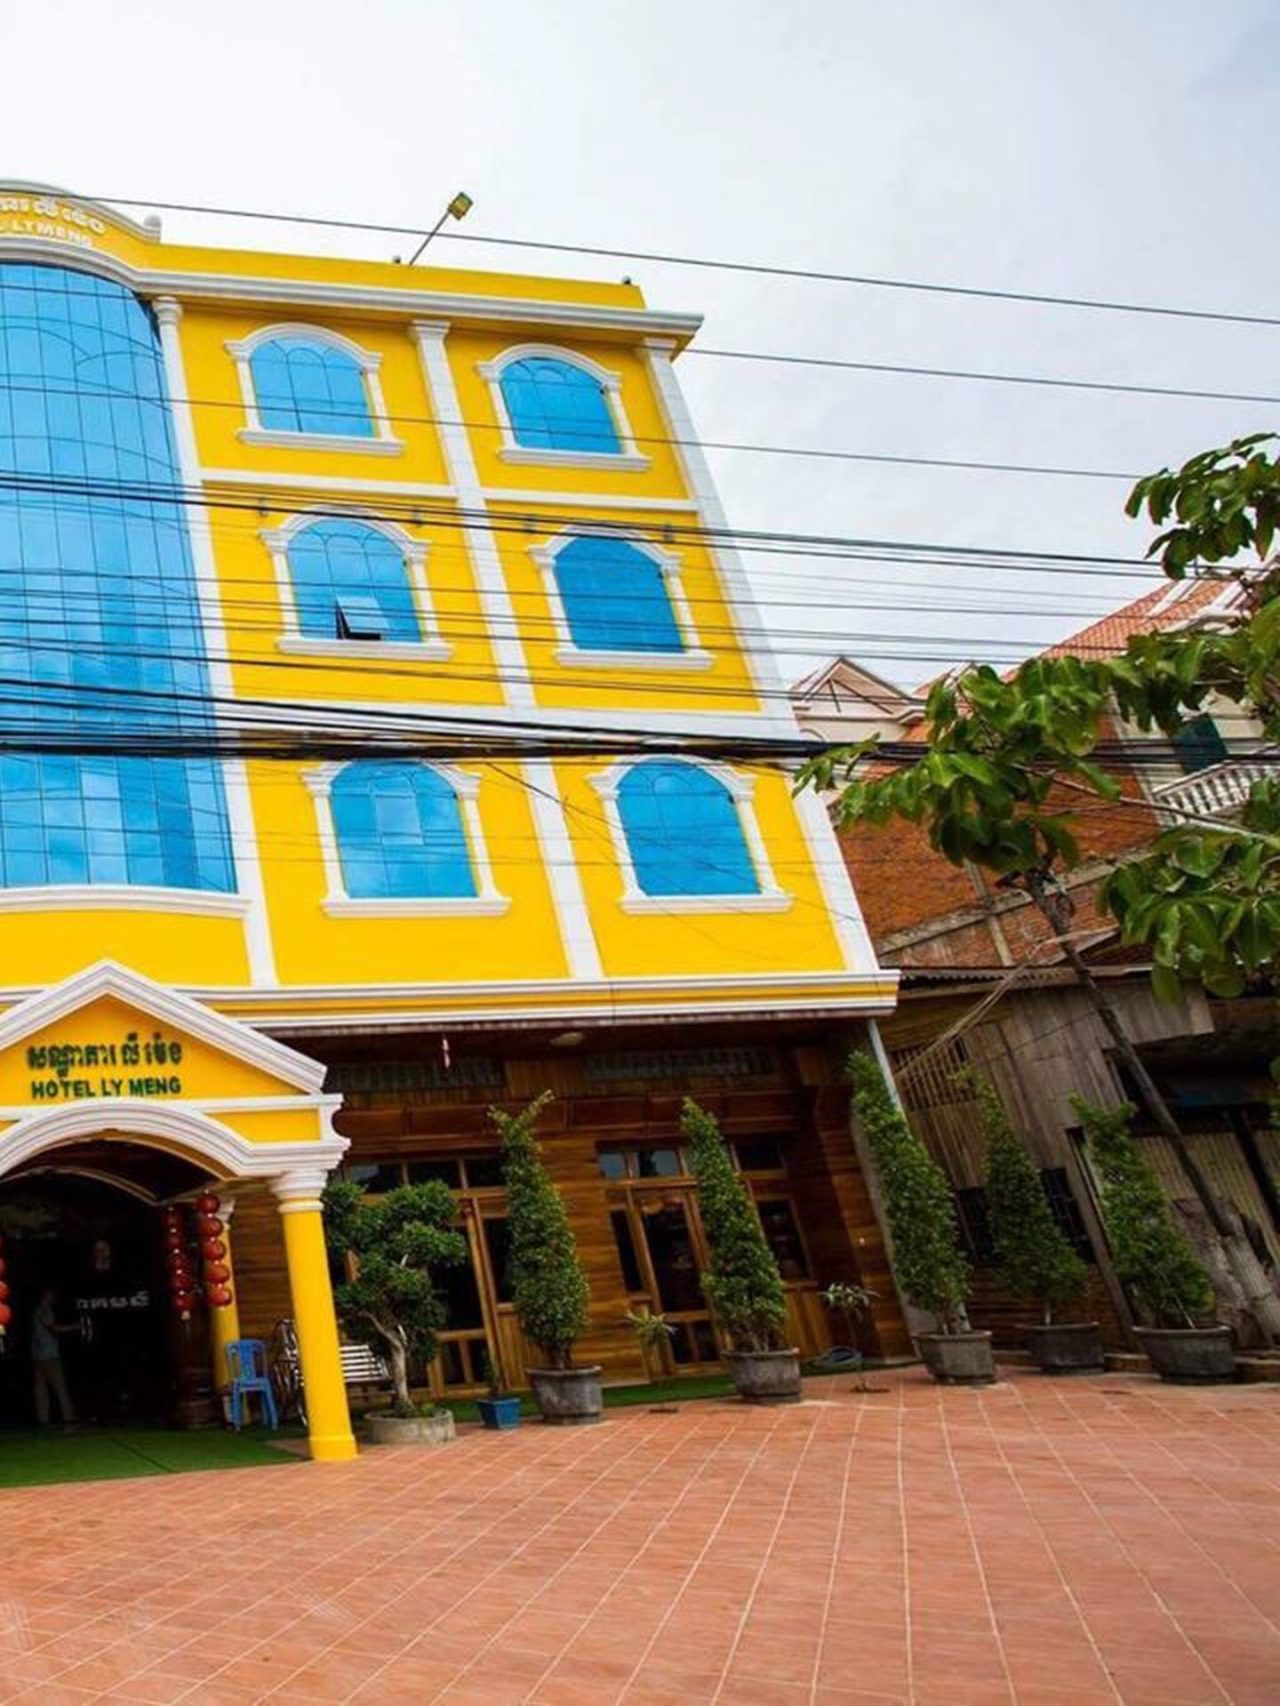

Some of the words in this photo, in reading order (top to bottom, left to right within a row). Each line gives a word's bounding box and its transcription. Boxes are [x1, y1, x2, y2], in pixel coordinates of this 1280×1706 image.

[31, 1079, 95, 1099] HOTEL
[101, 1078, 123, 1097] LY
[128, 1076, 182, 1097] MENG
